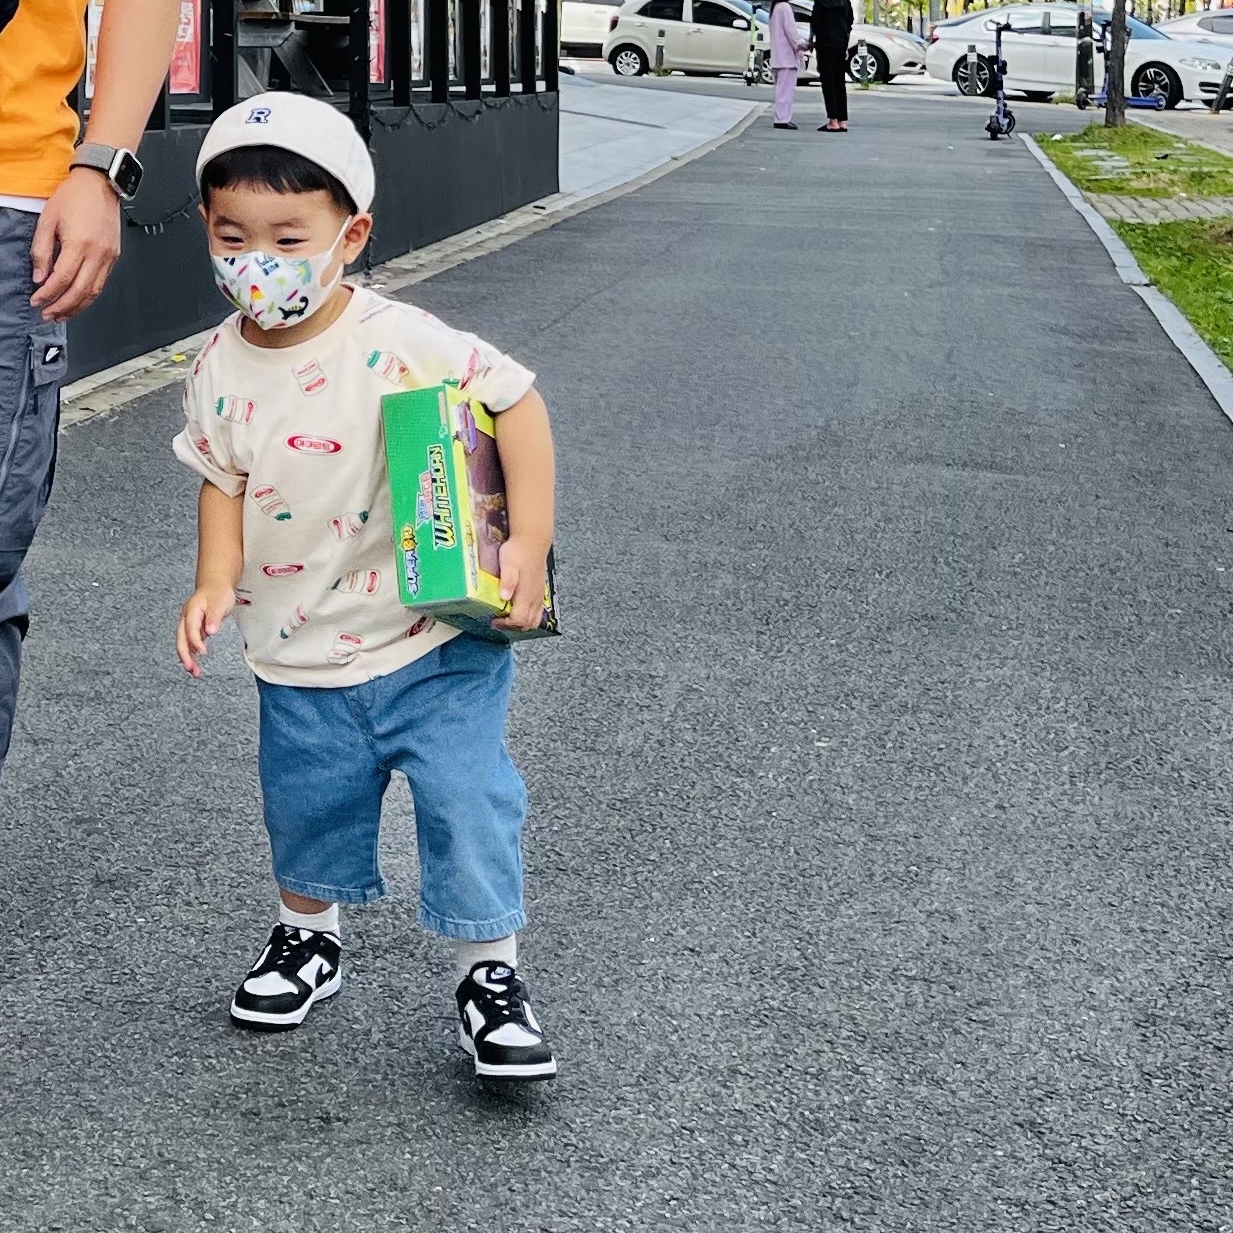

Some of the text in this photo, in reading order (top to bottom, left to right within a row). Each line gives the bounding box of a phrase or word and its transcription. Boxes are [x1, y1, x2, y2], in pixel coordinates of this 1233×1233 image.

[245, 108, 272, 124] R
[429, 445, 456, 548] WHITEHORN
[404, 550, 418, 596] SUPER
